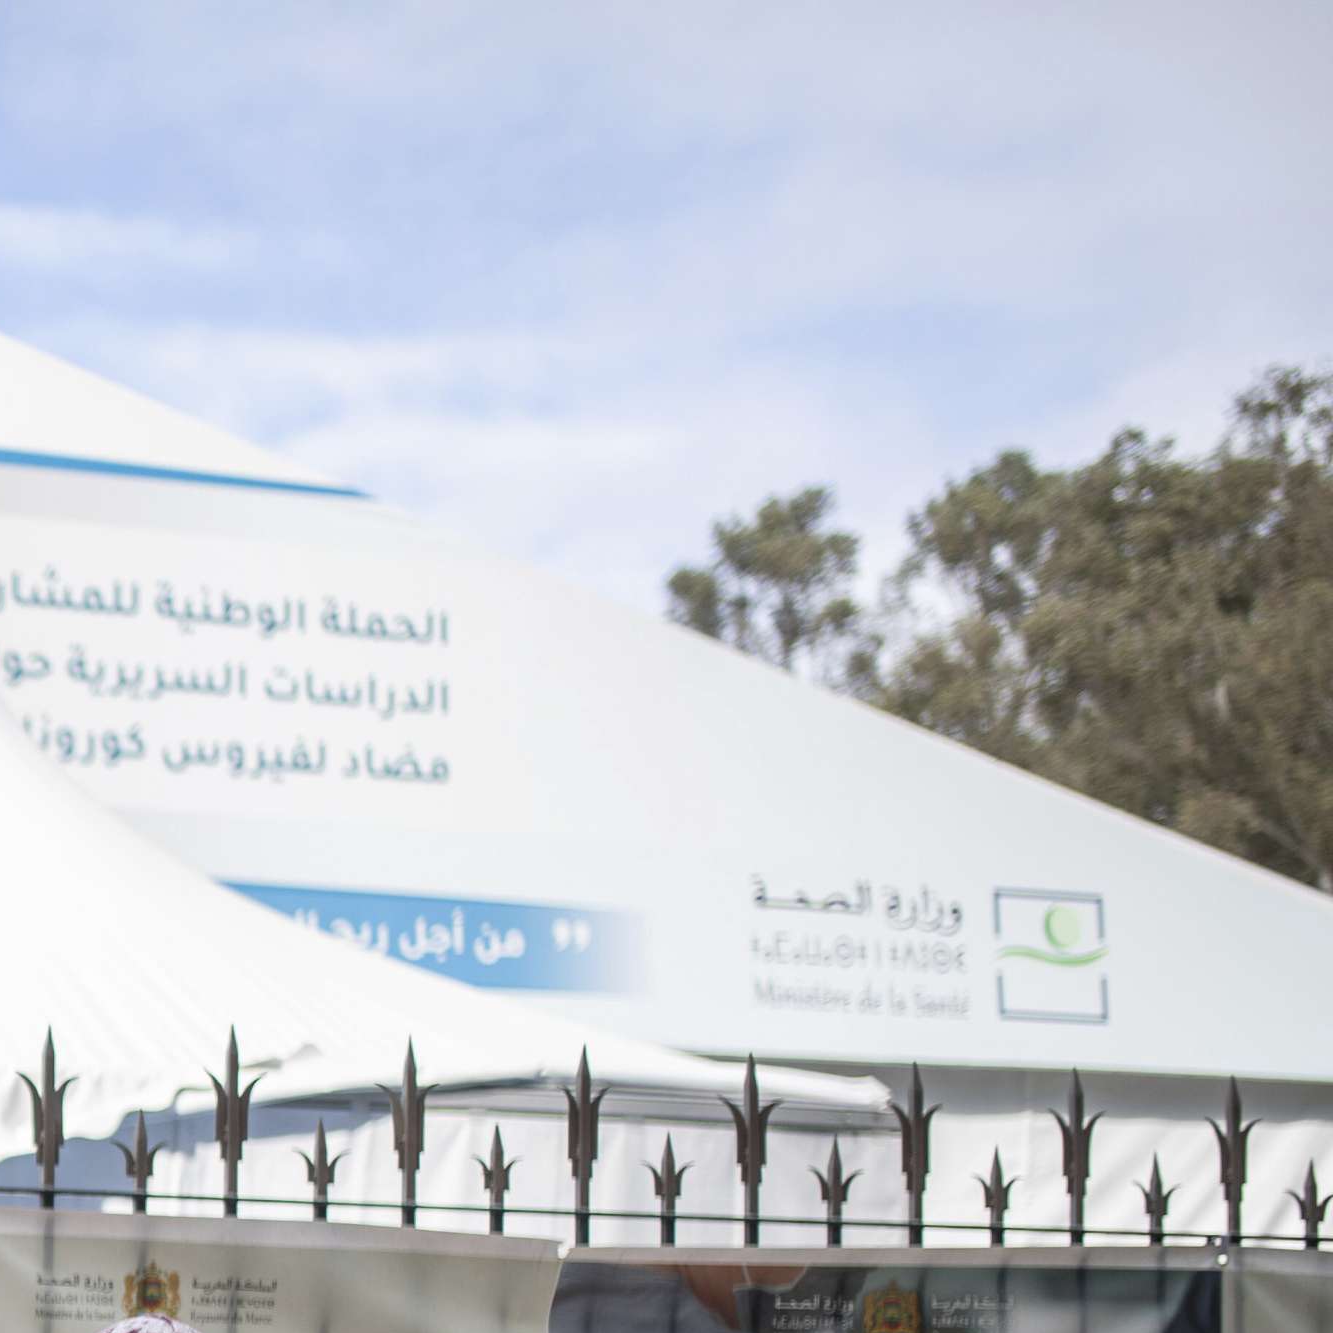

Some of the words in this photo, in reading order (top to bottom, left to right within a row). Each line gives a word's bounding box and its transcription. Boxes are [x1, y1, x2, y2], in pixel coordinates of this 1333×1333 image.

[154, 584, 308, 637] الوطنية
[320, 596, 450, 646] الحملة
[66, 643, 248, 698] السريرية
[264, 670, 450, 720] الدراسات
[161, 737, 327, 783] لفيروس
[342, 742, 450, 784] مضاد
[398, 905, 465, 964] أجل
[474, 921, 527, 966] من
